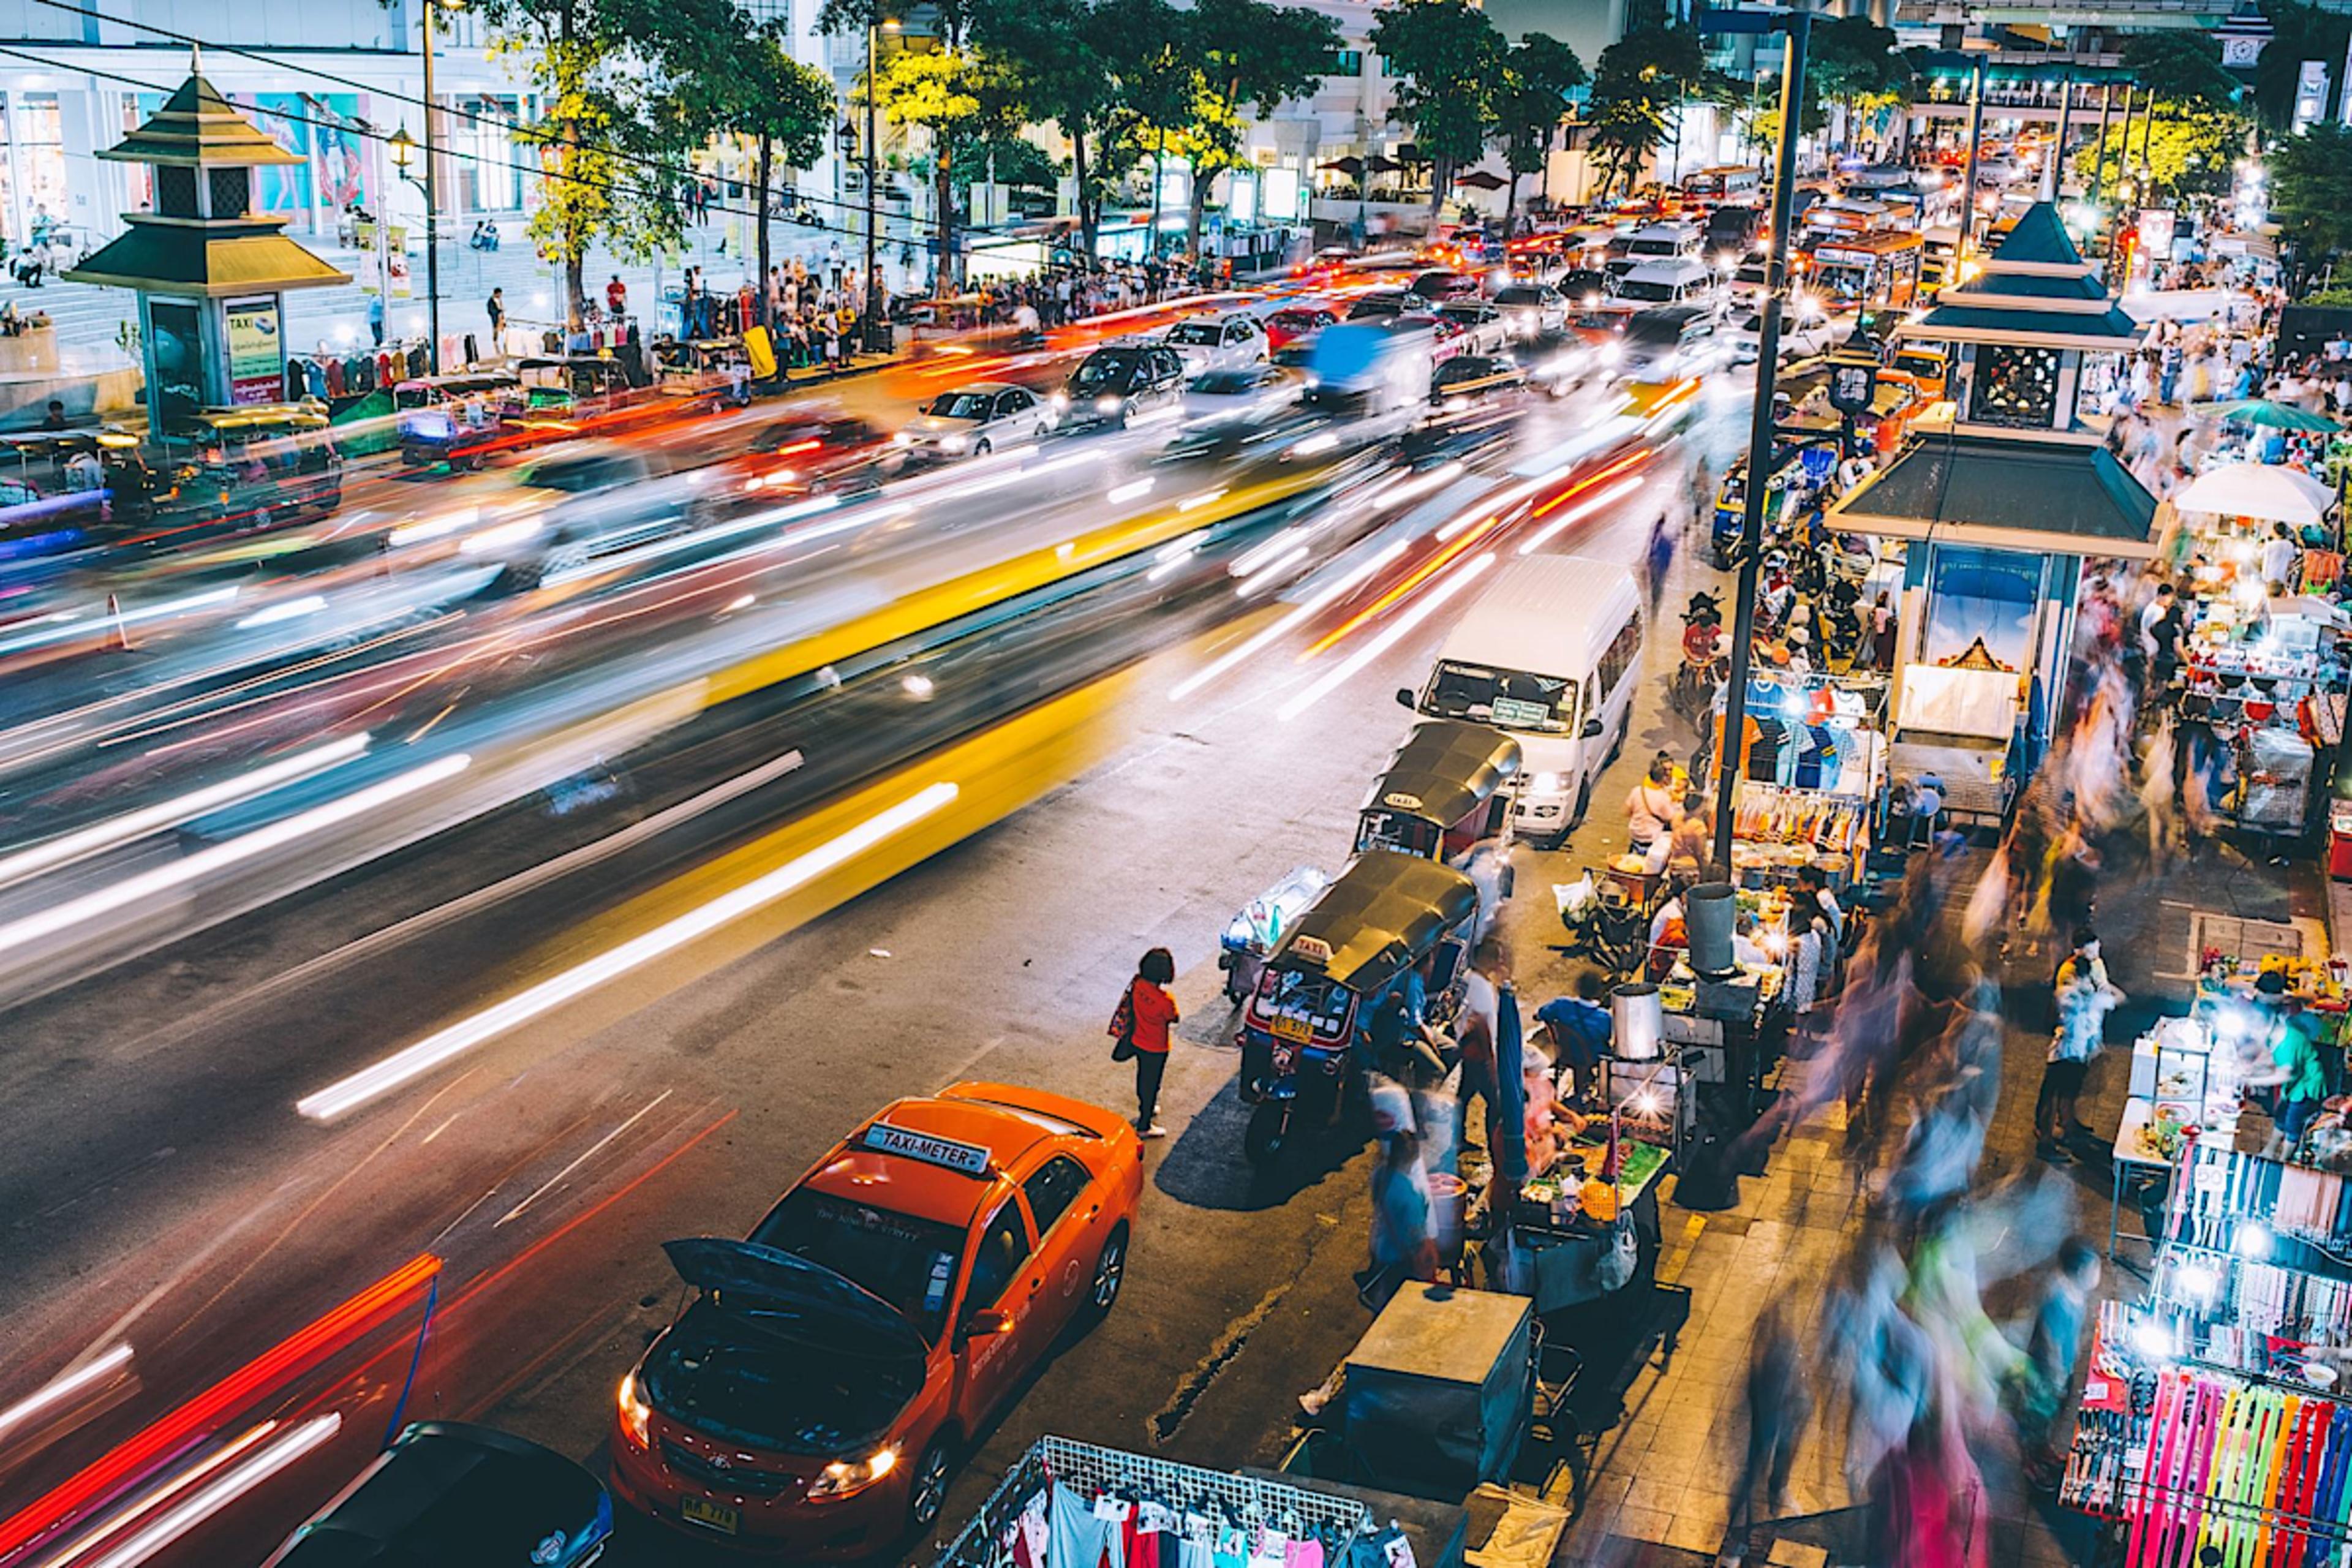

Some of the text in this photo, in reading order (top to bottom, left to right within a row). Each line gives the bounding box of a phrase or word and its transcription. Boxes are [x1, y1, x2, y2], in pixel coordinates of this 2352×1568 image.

[230, 318, 253, 330] TAXI
[1298, 938, 1325, 955] TAXI
[883, 1131, 969, 1165] TAXI-METER
[2196, 1167, 2223, 1186] 50
